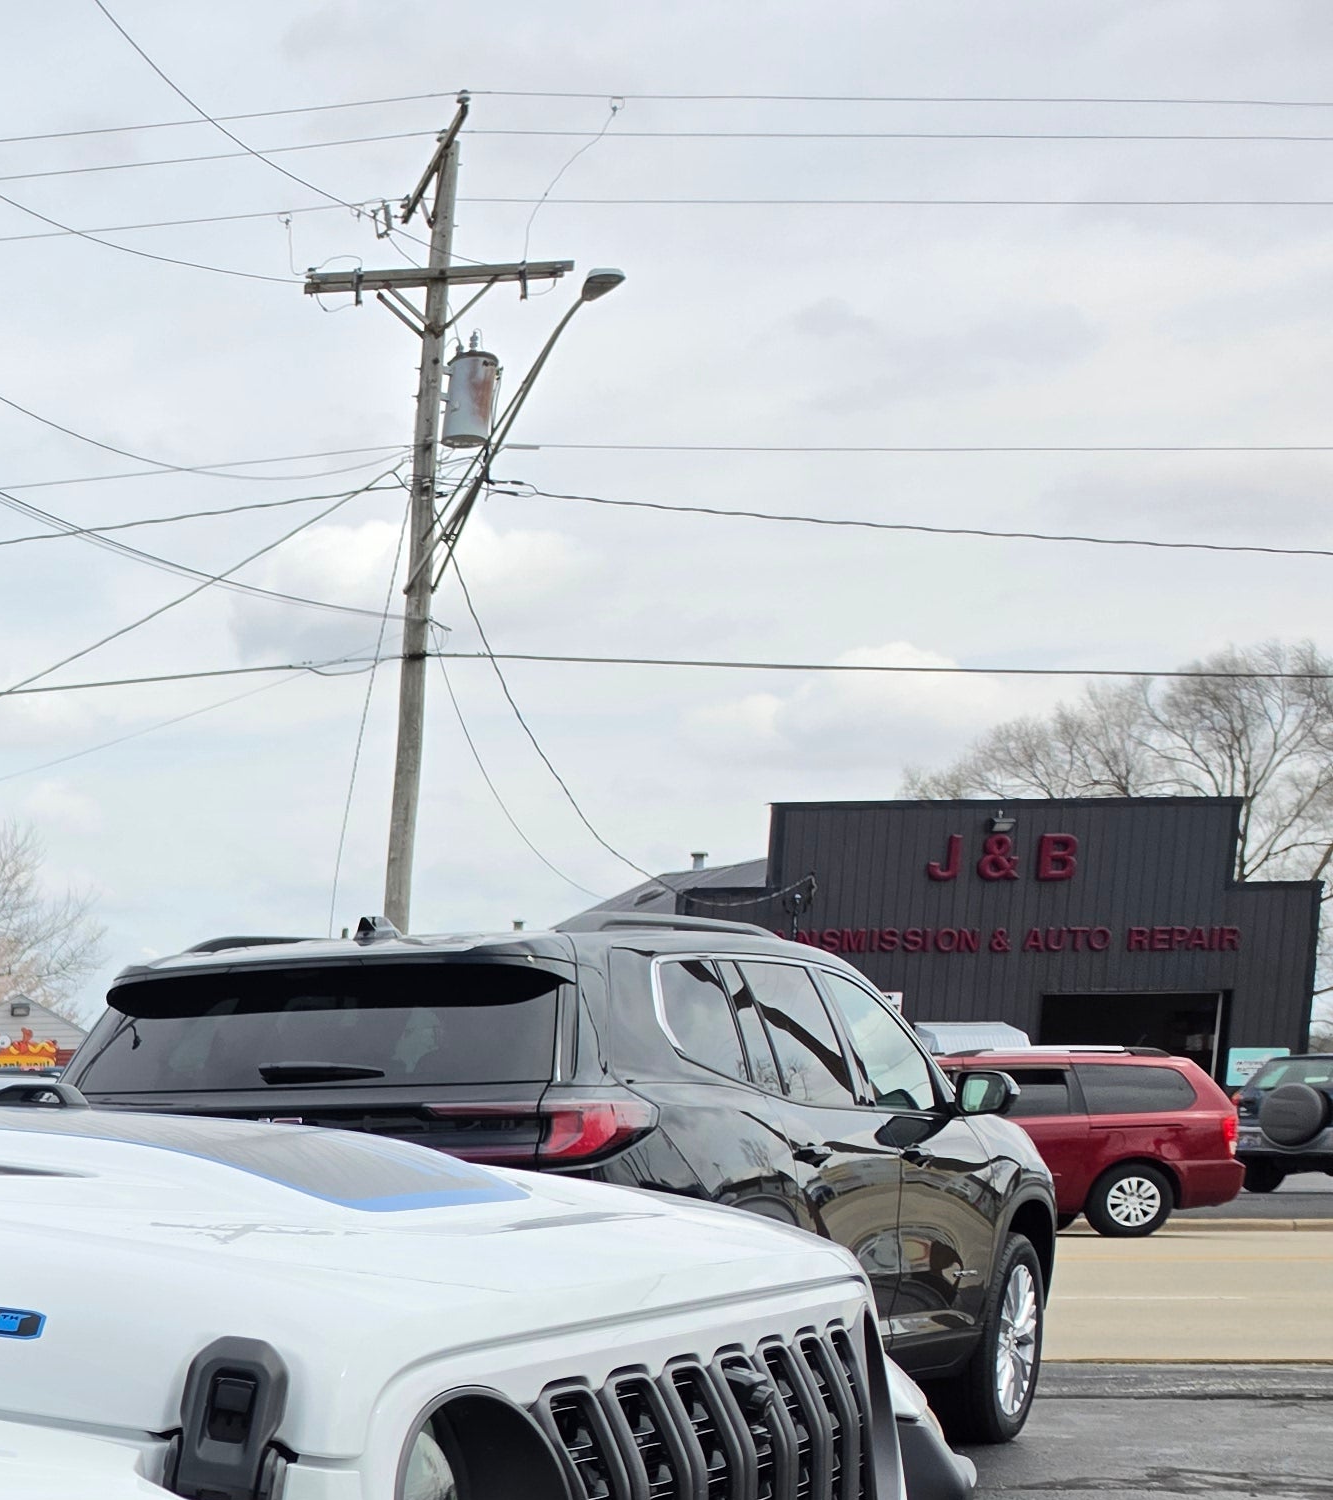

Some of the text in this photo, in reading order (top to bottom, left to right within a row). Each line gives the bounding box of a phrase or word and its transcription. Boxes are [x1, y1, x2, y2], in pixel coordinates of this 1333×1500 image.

[926, 832, 1080, 882] J & B
[774, 925, 1242, 953] NSMISSION & AUTO REPAIR
